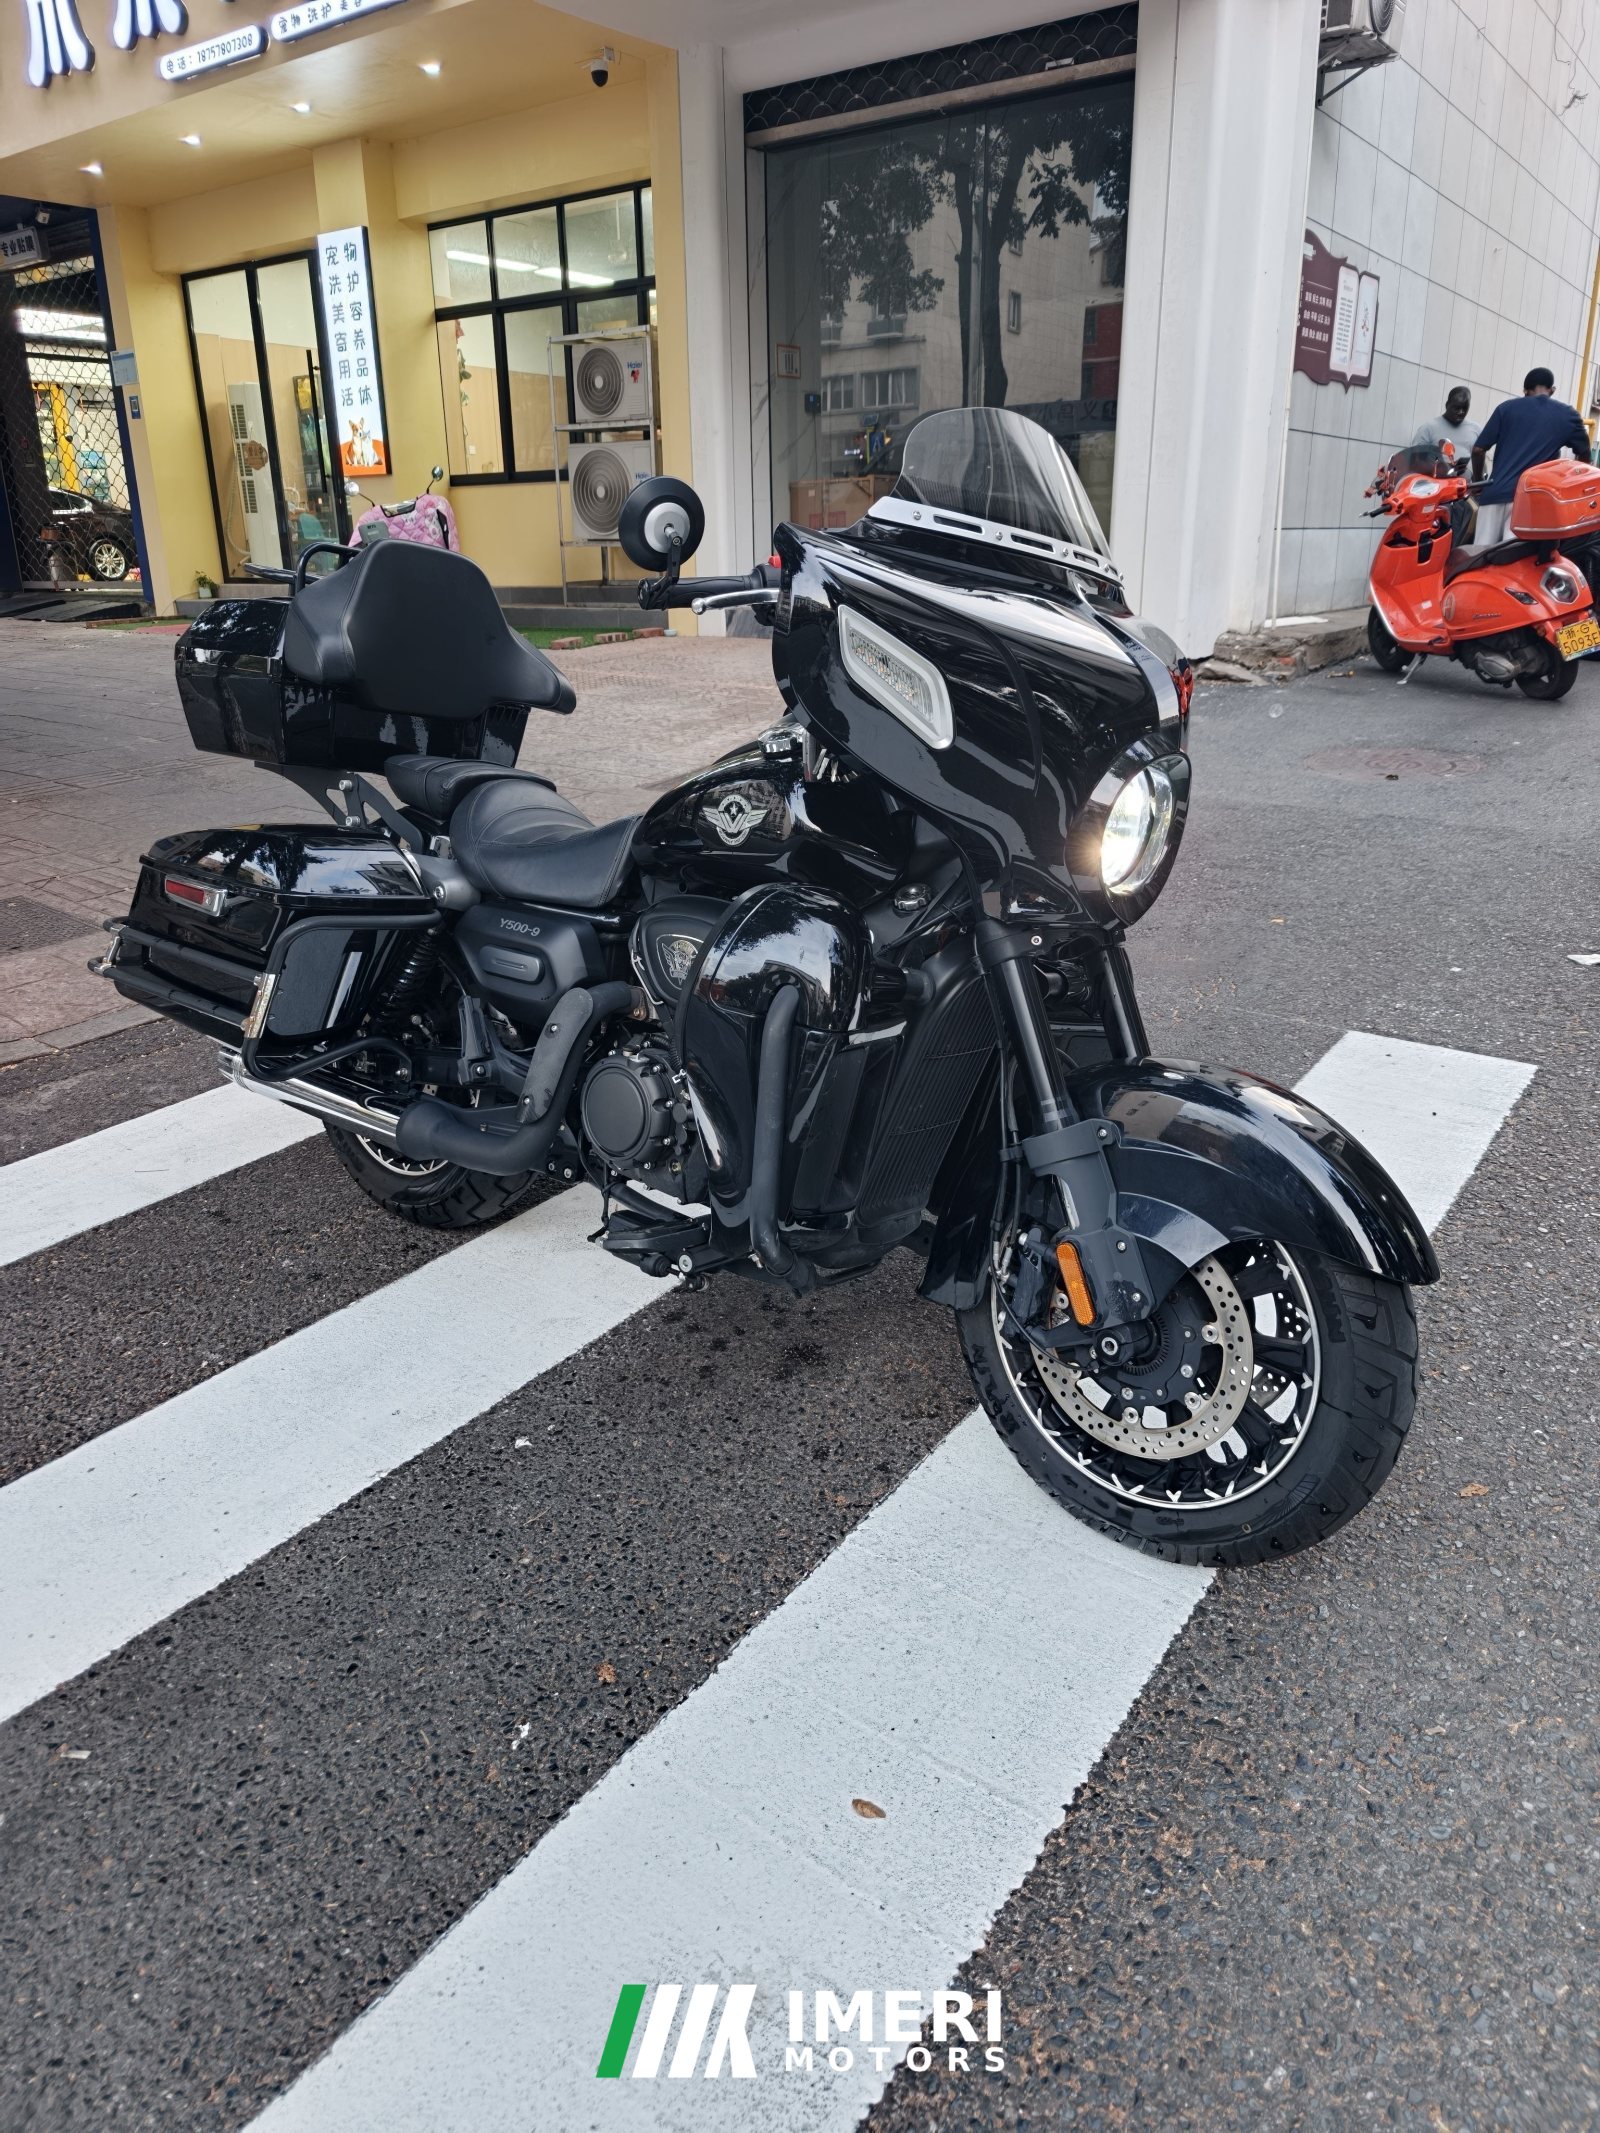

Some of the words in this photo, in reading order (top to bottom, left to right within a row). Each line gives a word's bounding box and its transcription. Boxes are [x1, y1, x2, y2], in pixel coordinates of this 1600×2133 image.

[325, 242, 358, 266] 宠物
[328, 271, 360, 295] 洗护
[332, 301, 363, 325] 美容
[334, 328, 366, 353] 寄养
[338, 357, 369, 380] 用品
[341, 386, 373, 407] 活体
[500, 918, 541, 937] Y500-9
